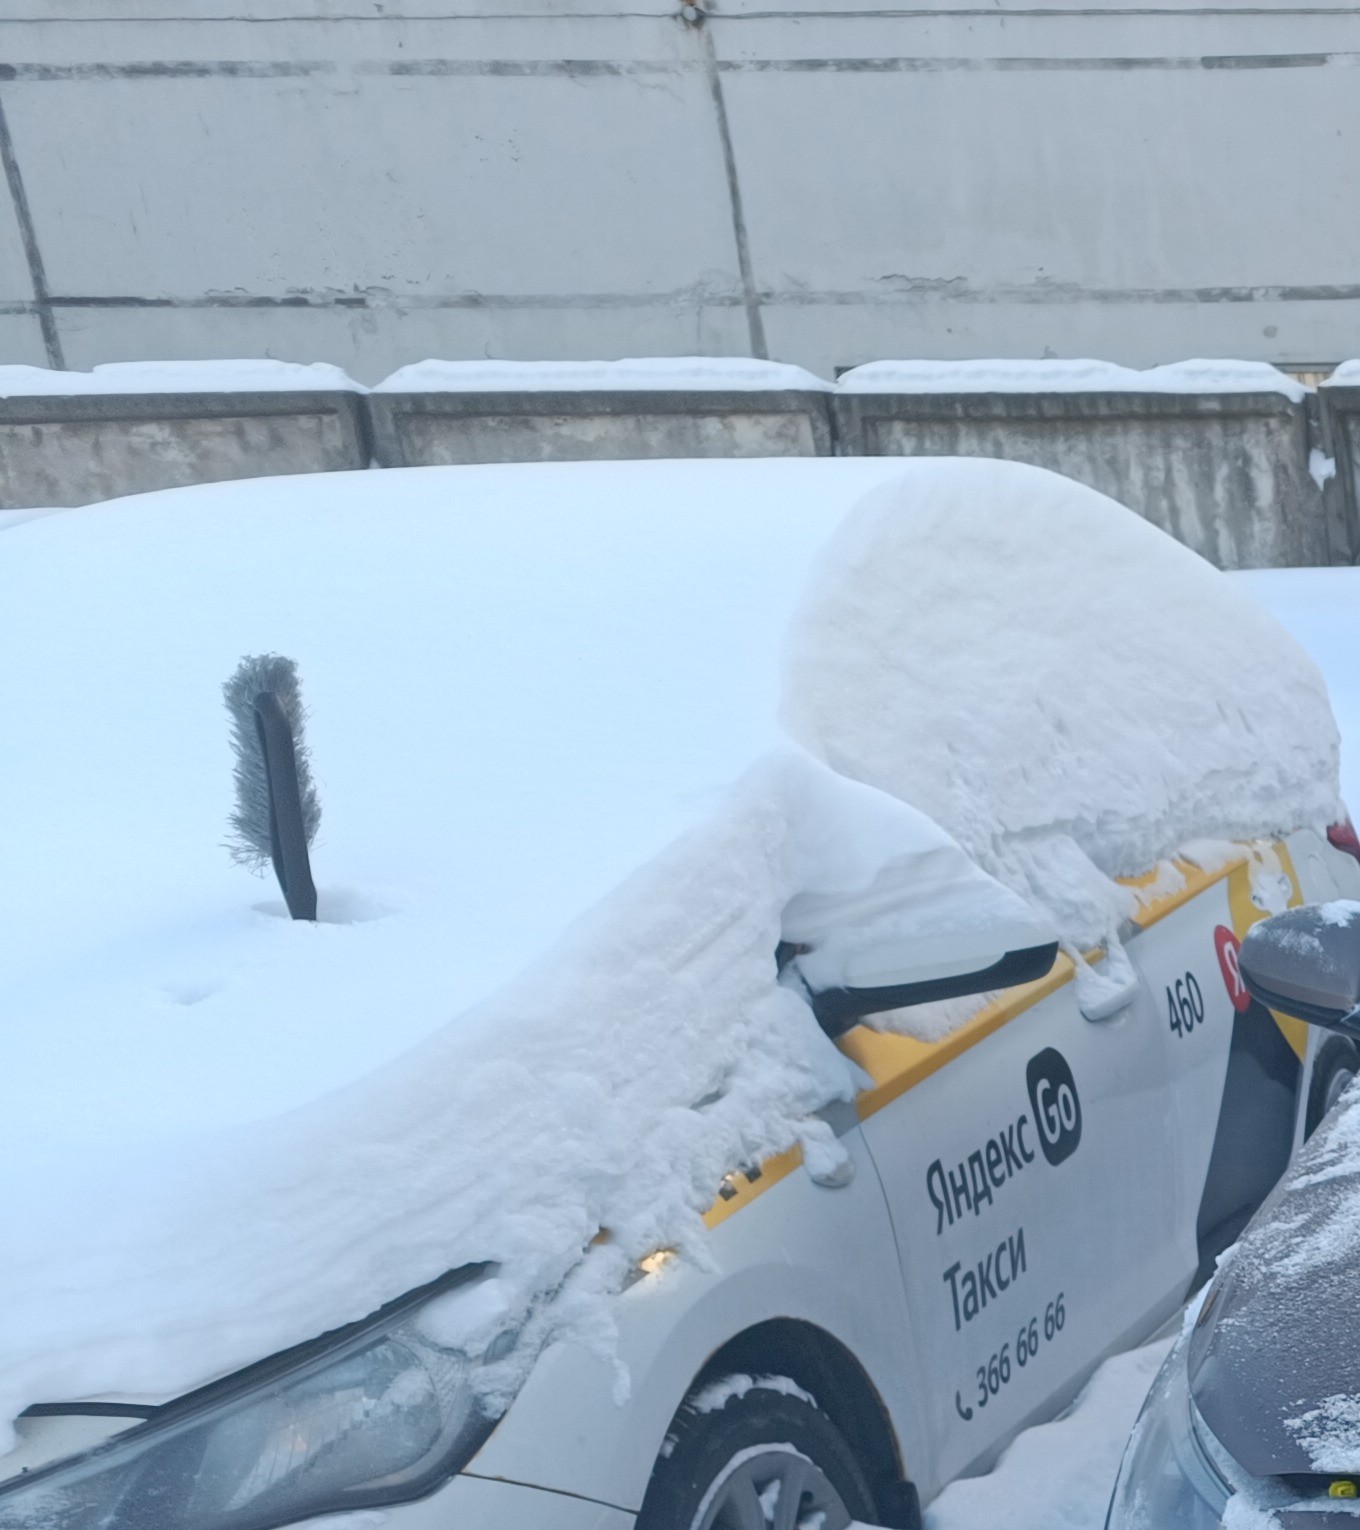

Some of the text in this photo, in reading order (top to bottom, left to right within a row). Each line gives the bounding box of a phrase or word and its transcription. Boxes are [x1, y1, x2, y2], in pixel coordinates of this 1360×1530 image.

[1166, 971, 1205, 1038] 460
[926, 1078, 1076, 1235] Яндекс Go
[943, 1227, 1027, 1331] Такси
[976, 1291, 1066, 1408] 366 66 66
